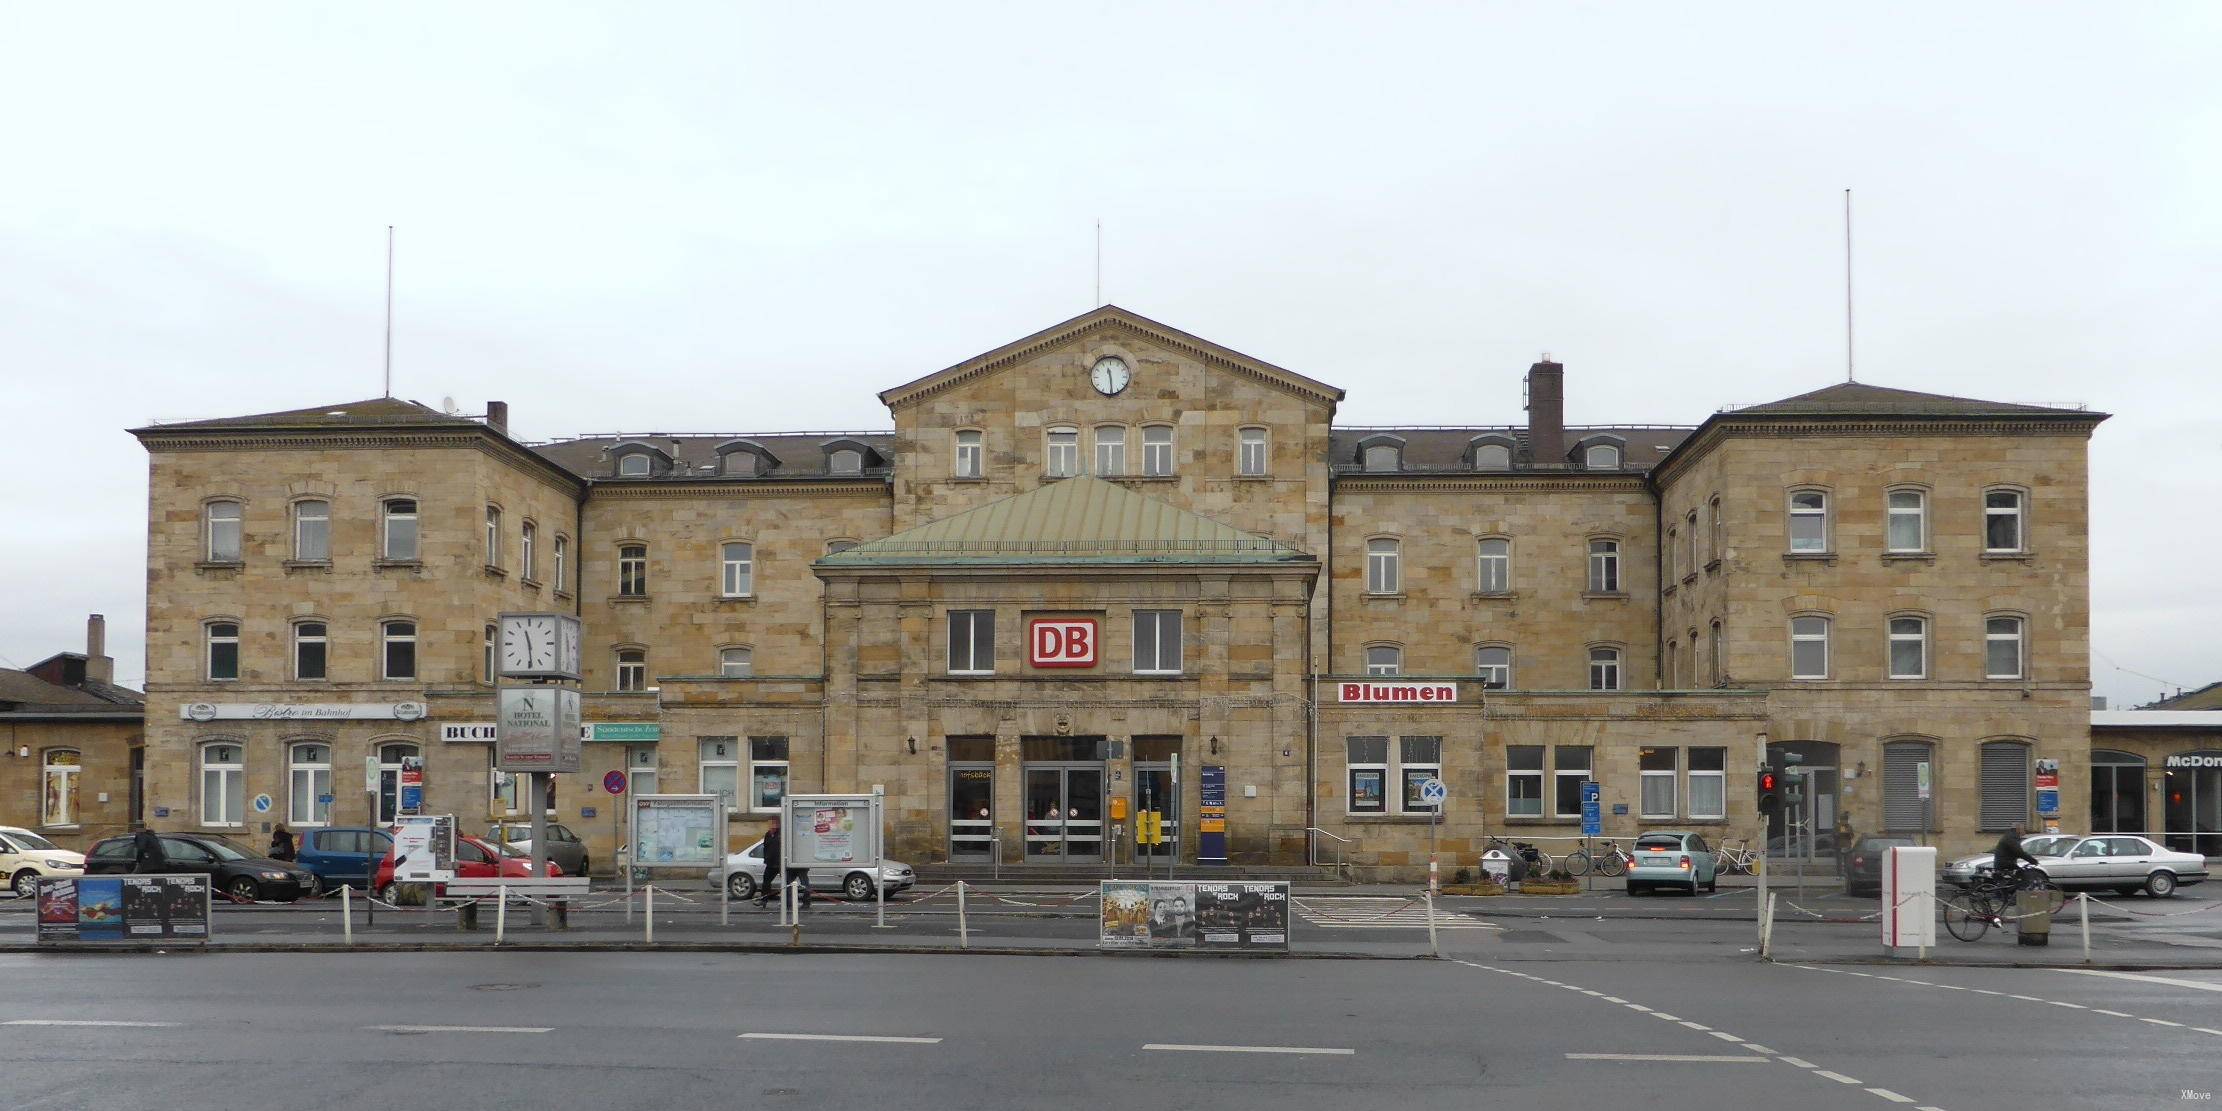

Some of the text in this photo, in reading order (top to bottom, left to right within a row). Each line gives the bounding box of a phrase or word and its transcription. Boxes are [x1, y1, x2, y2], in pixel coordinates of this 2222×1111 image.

[1039, 627, 1088, 658] DB
[1343, 684, 1452, 700] Blumen
[302, 708, 312, 716] im
[315, 708, 352, 718] Bahnhof
[514, 711, 544, 719] HOTEL
[2166, 756, 2222, 767] McDon
[1591, 793, 1598, 801] P
[142, 885, 162, 893] ROCK
[184, 885, 205, 893] ROCK
[1217, 892, 1239, 900] ROCK
